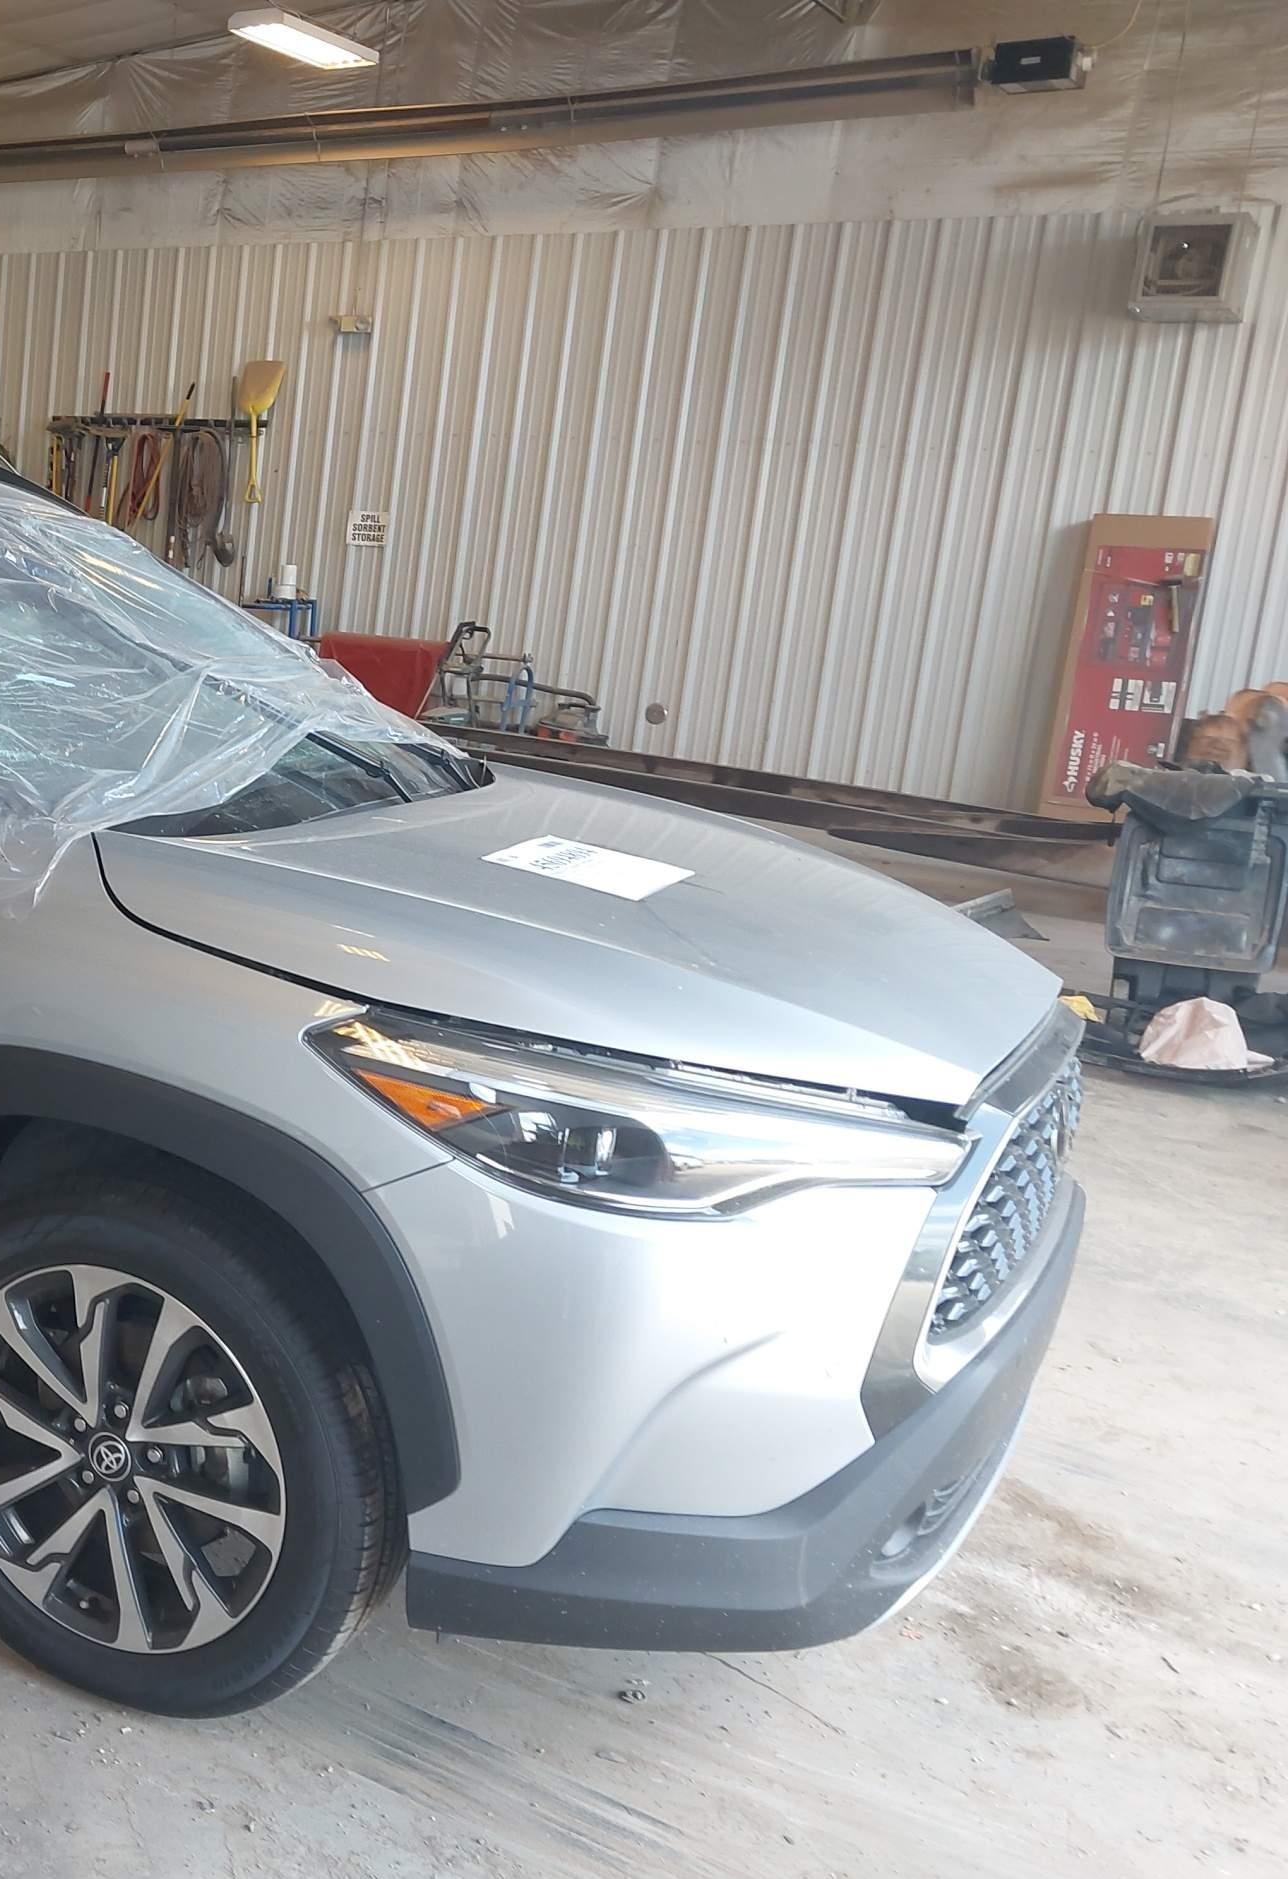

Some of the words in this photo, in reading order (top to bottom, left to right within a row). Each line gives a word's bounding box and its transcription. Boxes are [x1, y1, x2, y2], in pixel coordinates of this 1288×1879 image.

[360, 514, 380, 523] SPILL
[352, 523, 386, 533] SORBENT
[352, 532, 384, 542] STORAGE
[1067, 730, 1085, 777] HUSKY
